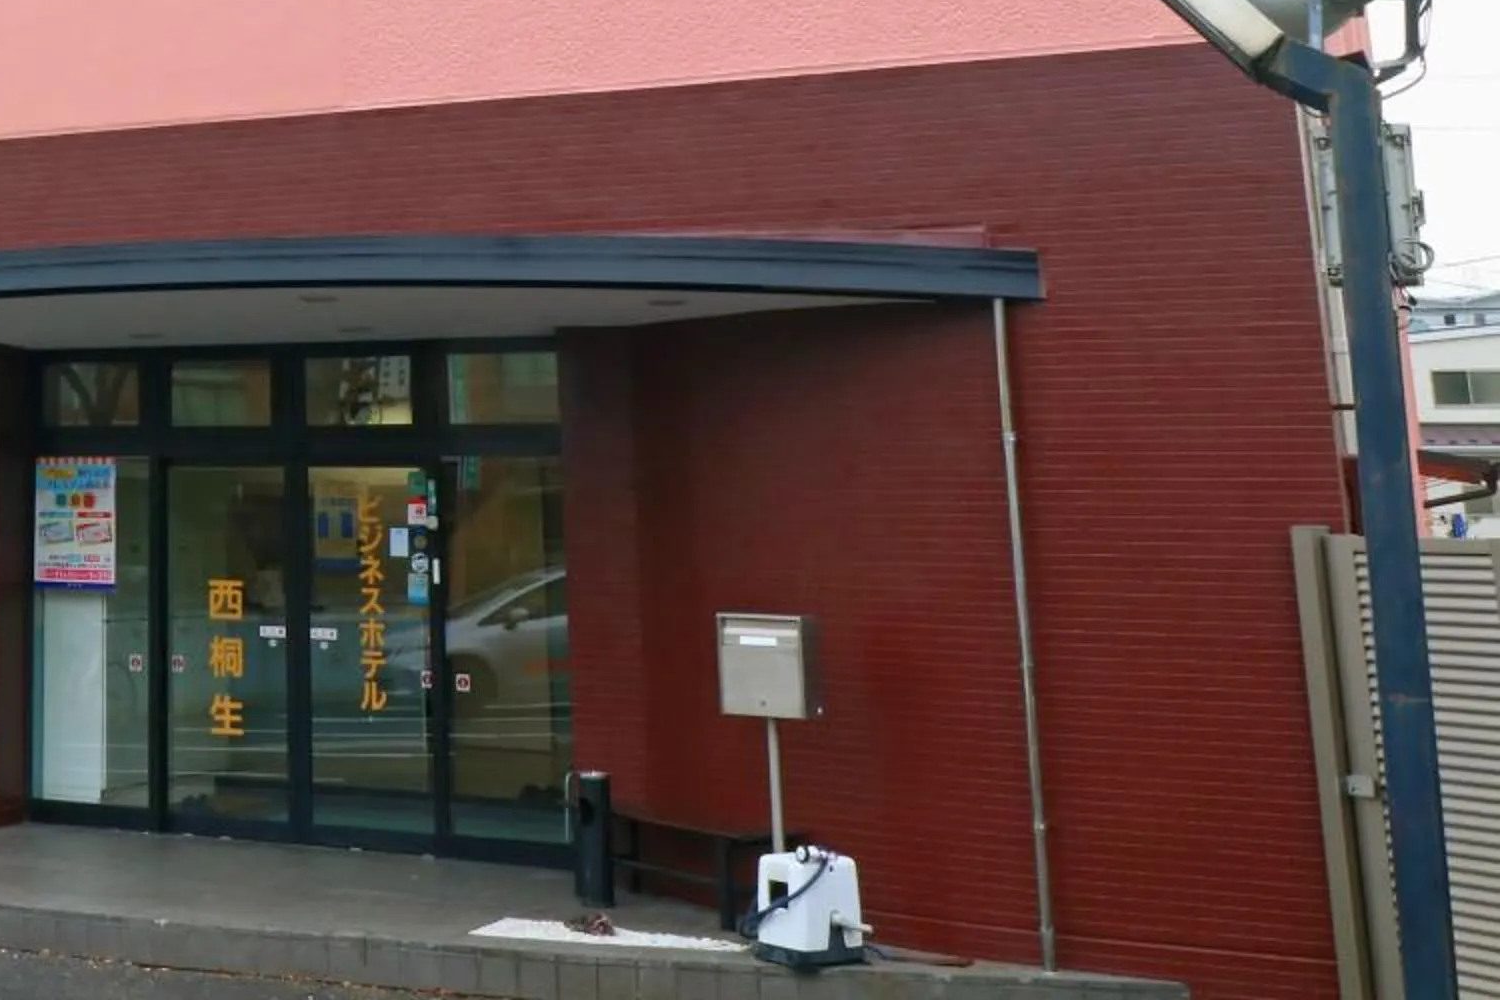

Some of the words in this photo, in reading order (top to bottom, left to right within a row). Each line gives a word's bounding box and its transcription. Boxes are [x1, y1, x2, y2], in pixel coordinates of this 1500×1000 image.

[208, 578, 245, 737] 西桐生
[357, 493, 388, 712] ビジネスホテル
